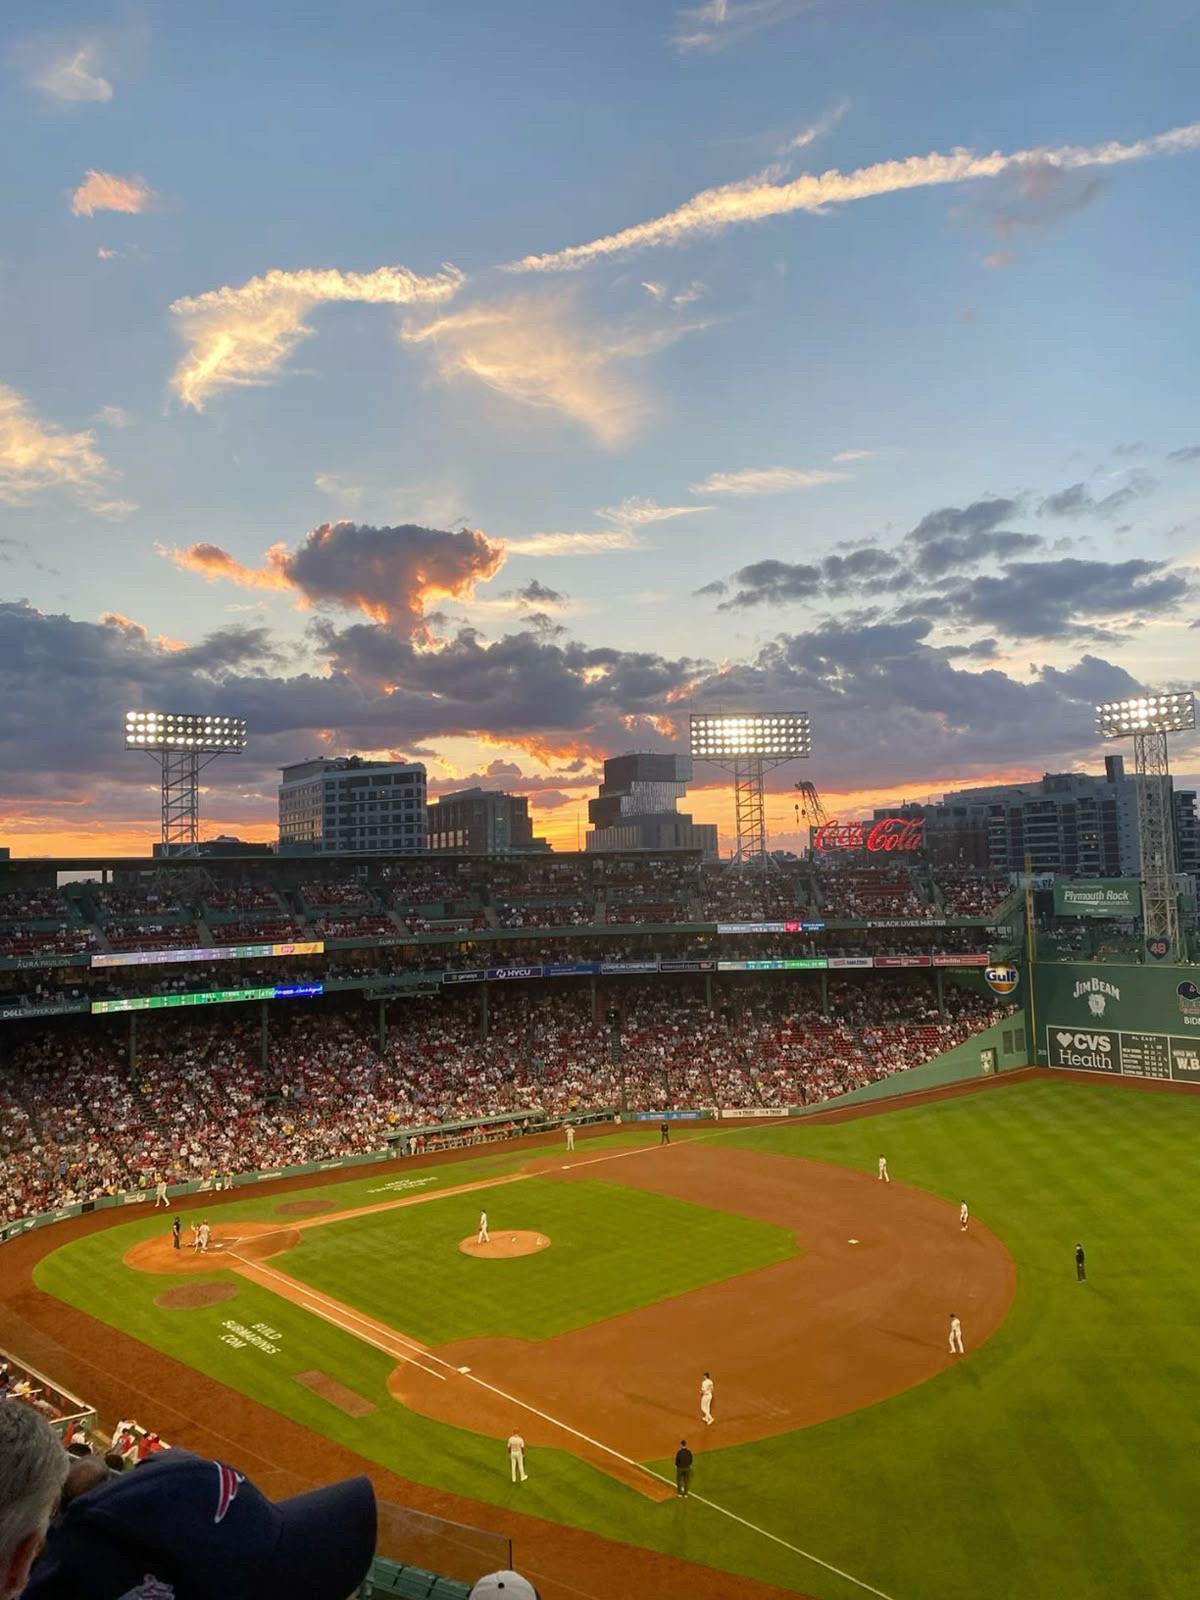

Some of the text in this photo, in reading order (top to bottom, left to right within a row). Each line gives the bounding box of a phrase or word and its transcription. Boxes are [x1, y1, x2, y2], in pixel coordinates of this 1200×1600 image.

[1064, 890, 1129, 902] Plymouth Rock
[920, 919, 946, 927] MATTER
[17, 959, 71, 969] AURA PAVILION
[507, 969, 531, 977] HYCU
[987, 970, 1016, 981] Gulf
[1073, 977, 1120, 1001] JIM BEAM
[3, 1008, 23, 1018] DELL
[1073, 1033, 1112, 1052] CVS
[1058, 1049, 1113, 1069] Health
[222, 1320, 282, 1354] SUBMARINES
[251, 1323, 283, 1340] BUILD
